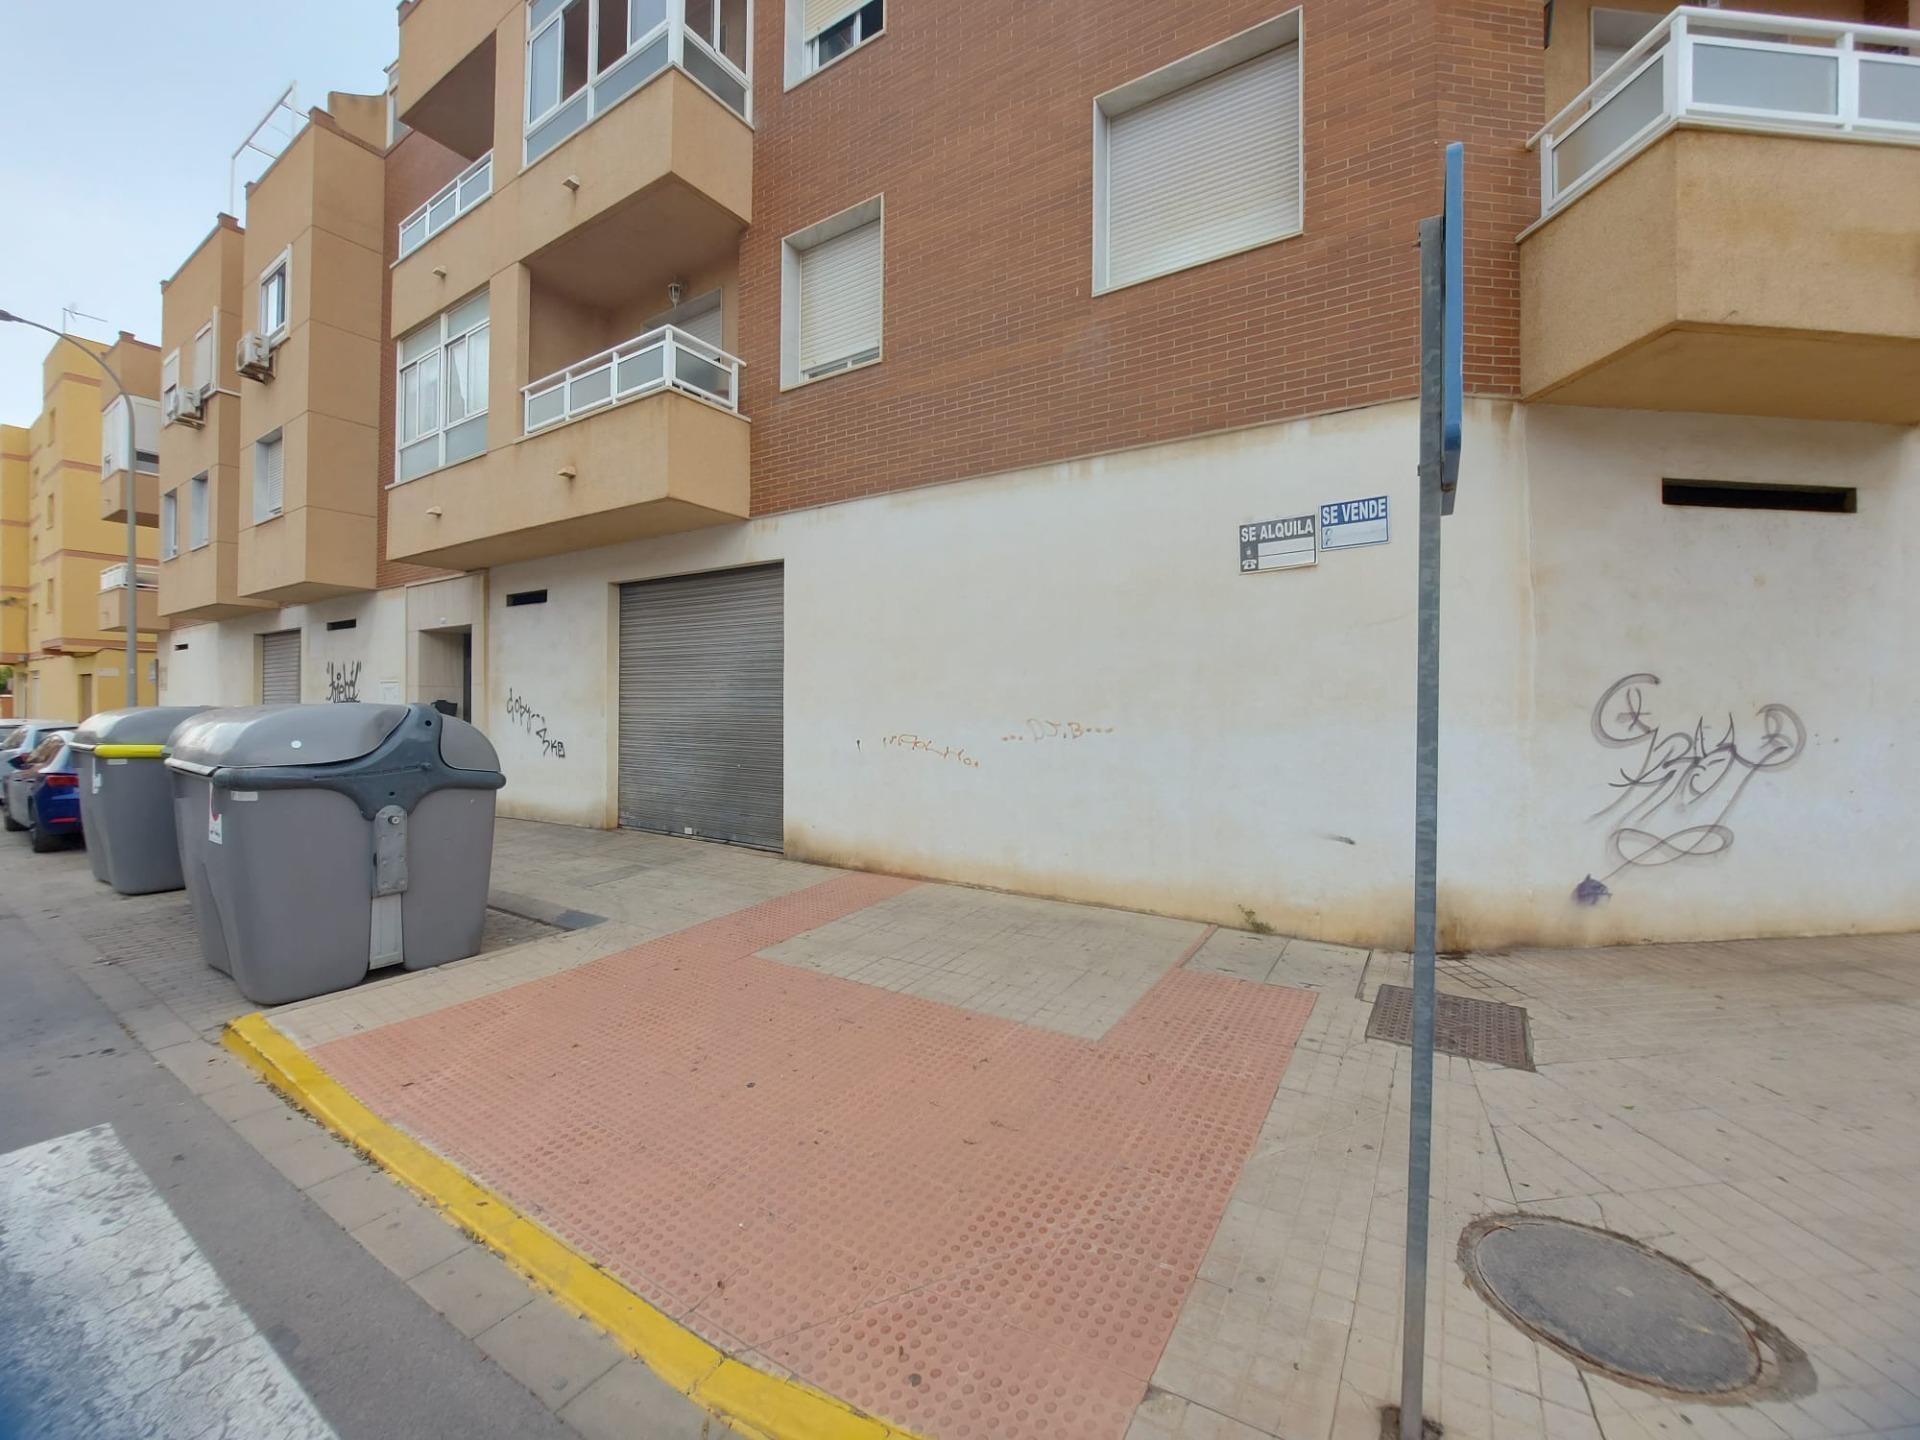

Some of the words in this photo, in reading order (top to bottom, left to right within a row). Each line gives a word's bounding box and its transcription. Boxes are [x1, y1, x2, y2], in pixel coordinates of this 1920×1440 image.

[1322, 506, 1338, 525] SE
[1341, 498, 1387, 521] VENDE
[1241, 525, 1257, 542] SE
[1260, 518, 1314, 540] ALQUILA
